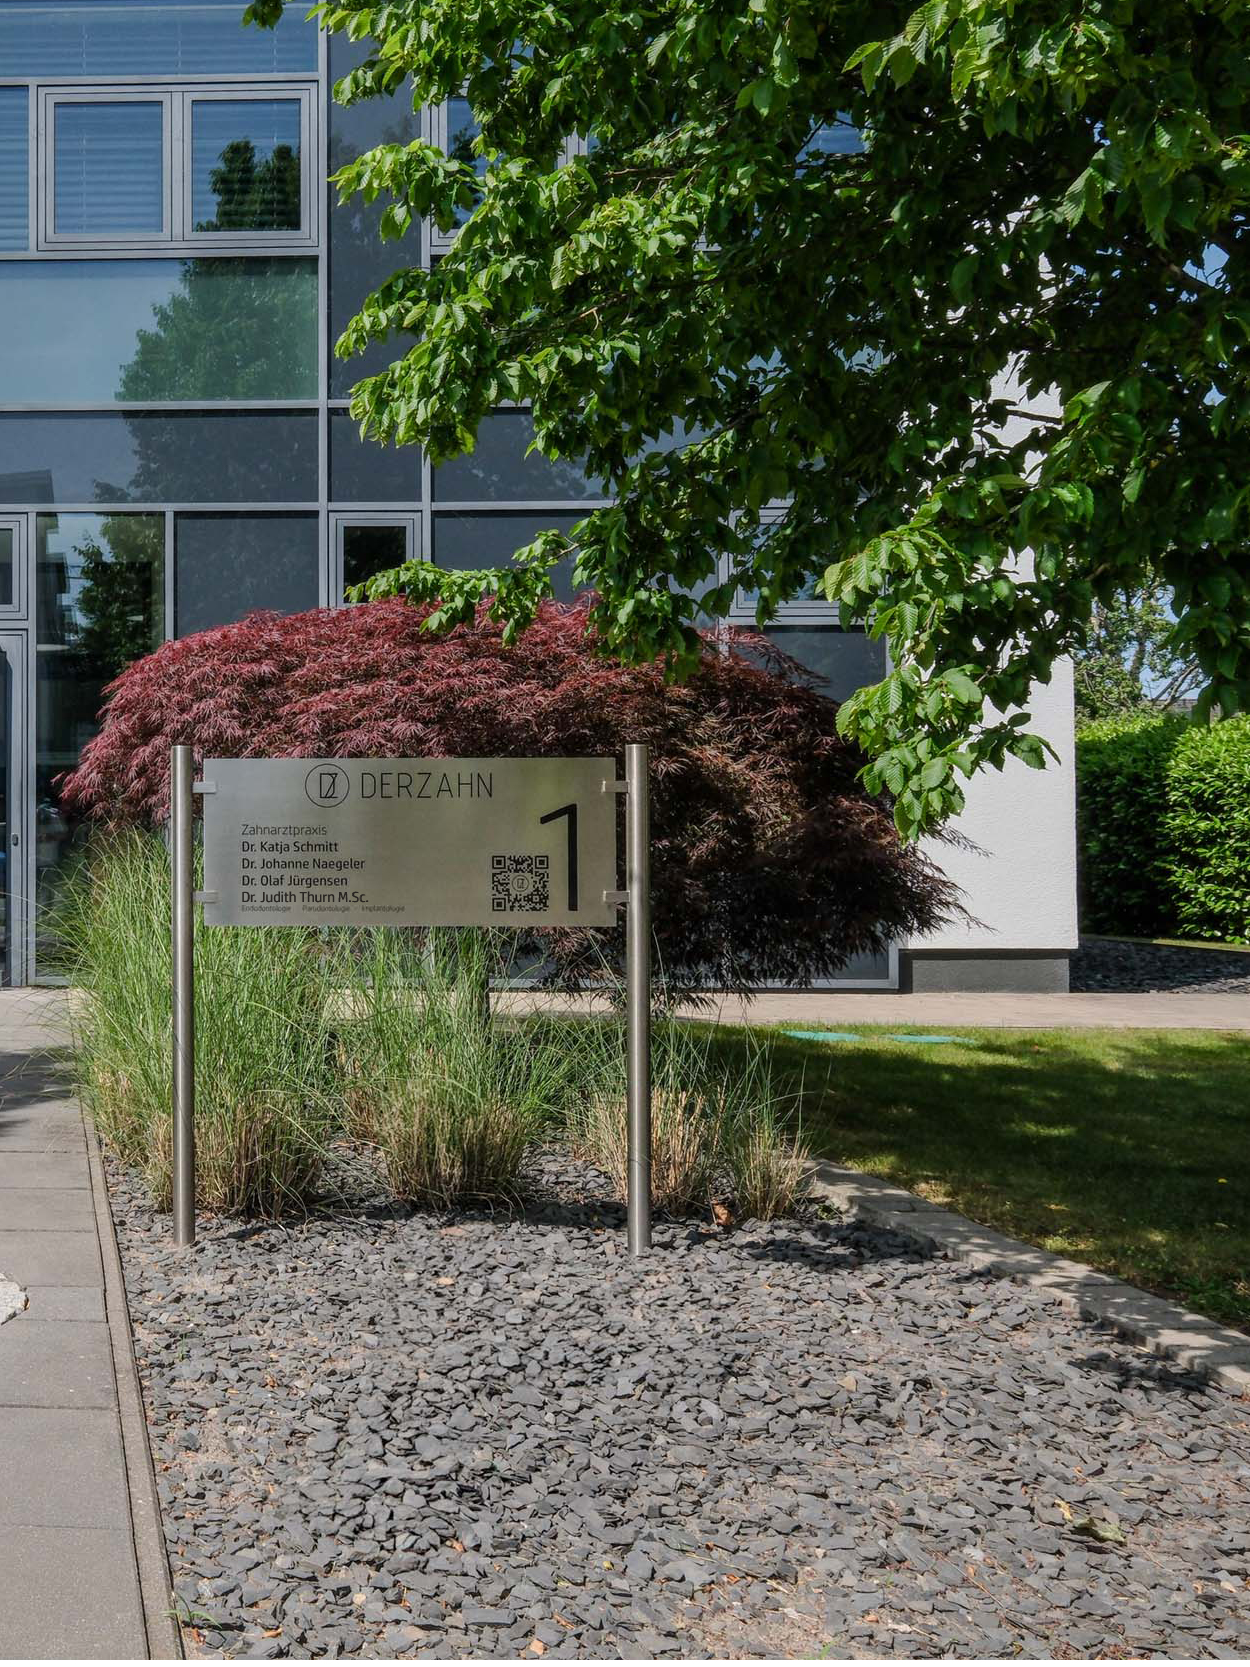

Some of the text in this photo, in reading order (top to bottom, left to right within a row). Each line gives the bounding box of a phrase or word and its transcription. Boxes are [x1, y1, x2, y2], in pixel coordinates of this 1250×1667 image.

[360, 772, 494, 799] DERZAHN
[241, 824, 328, 837] Zahnarztpraxis
[241, 841, 339, 854] Dr. Katja Schmitt
[539, 803, 578, 912] 1
[241, 858, 366, 872] Dr. Johanne Naegeler
[241, 874, 348, 888] Dr. Olaf Jürgensen
[241, 891, 369, 903] Dr. Judith Thurn M.Sc.
